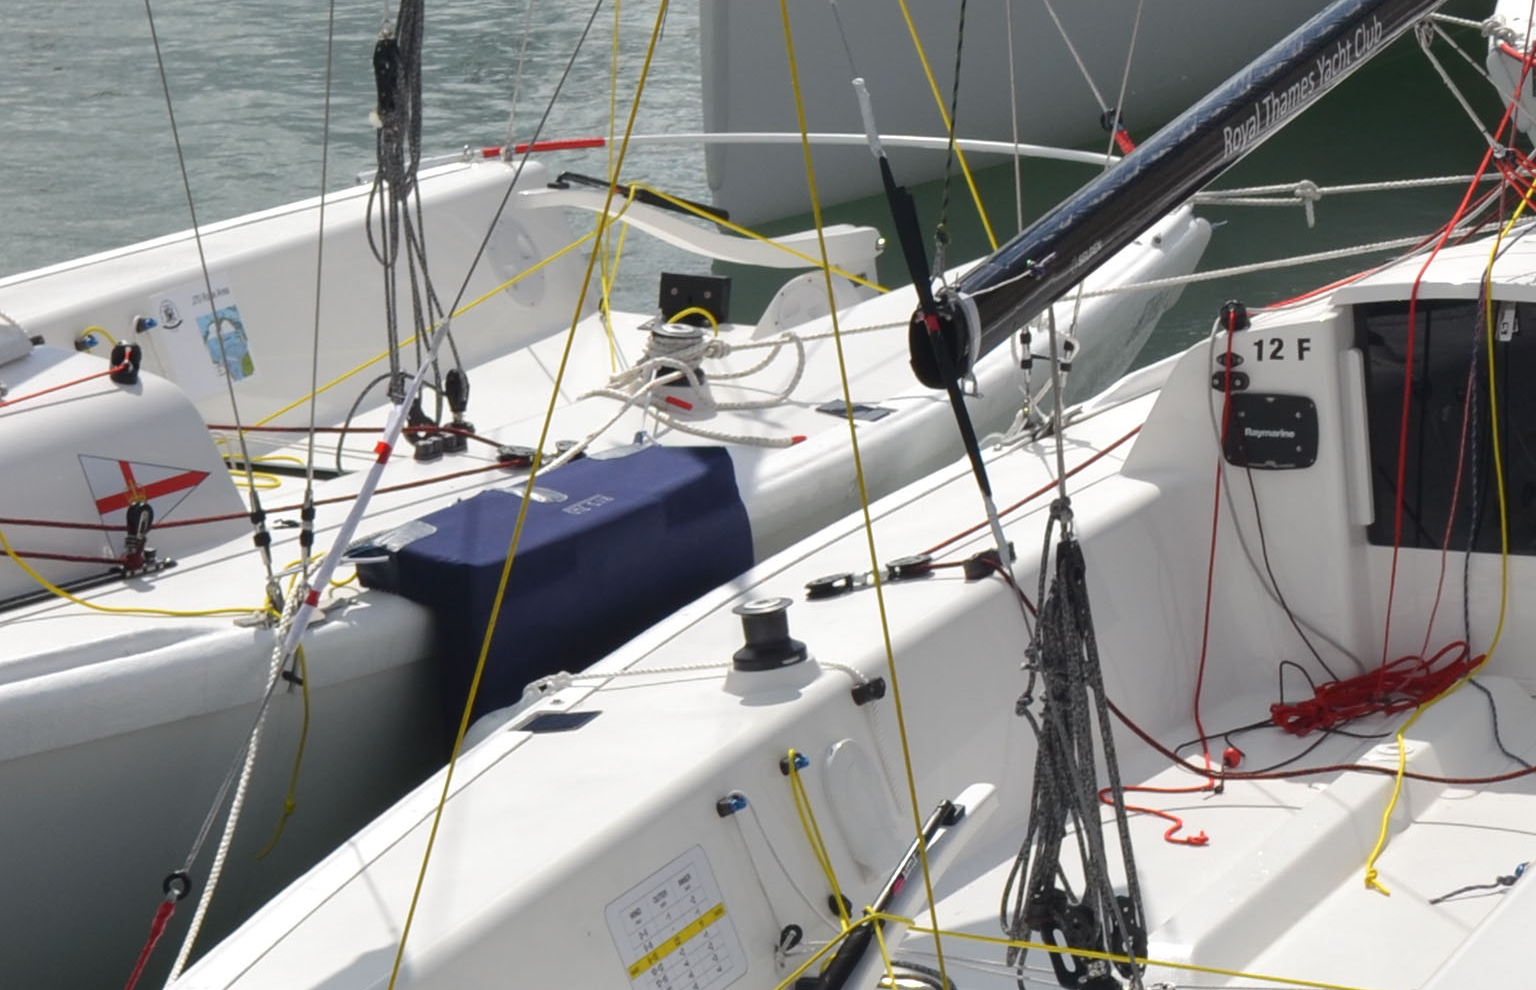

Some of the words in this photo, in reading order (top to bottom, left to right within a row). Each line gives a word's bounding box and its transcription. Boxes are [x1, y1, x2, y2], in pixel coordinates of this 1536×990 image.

[1223, 102, 1261, 158] Royal
[1262, 70, 1315, 127] Thames
[1316, 40, 1353, 87] Yacht
[1354, 14, 1383, 59] Club
[1253, 338, 1285, 361] 12
[1297, 338, 1311, 360] F
[1244, 427, 1295, 439] Raymarine
